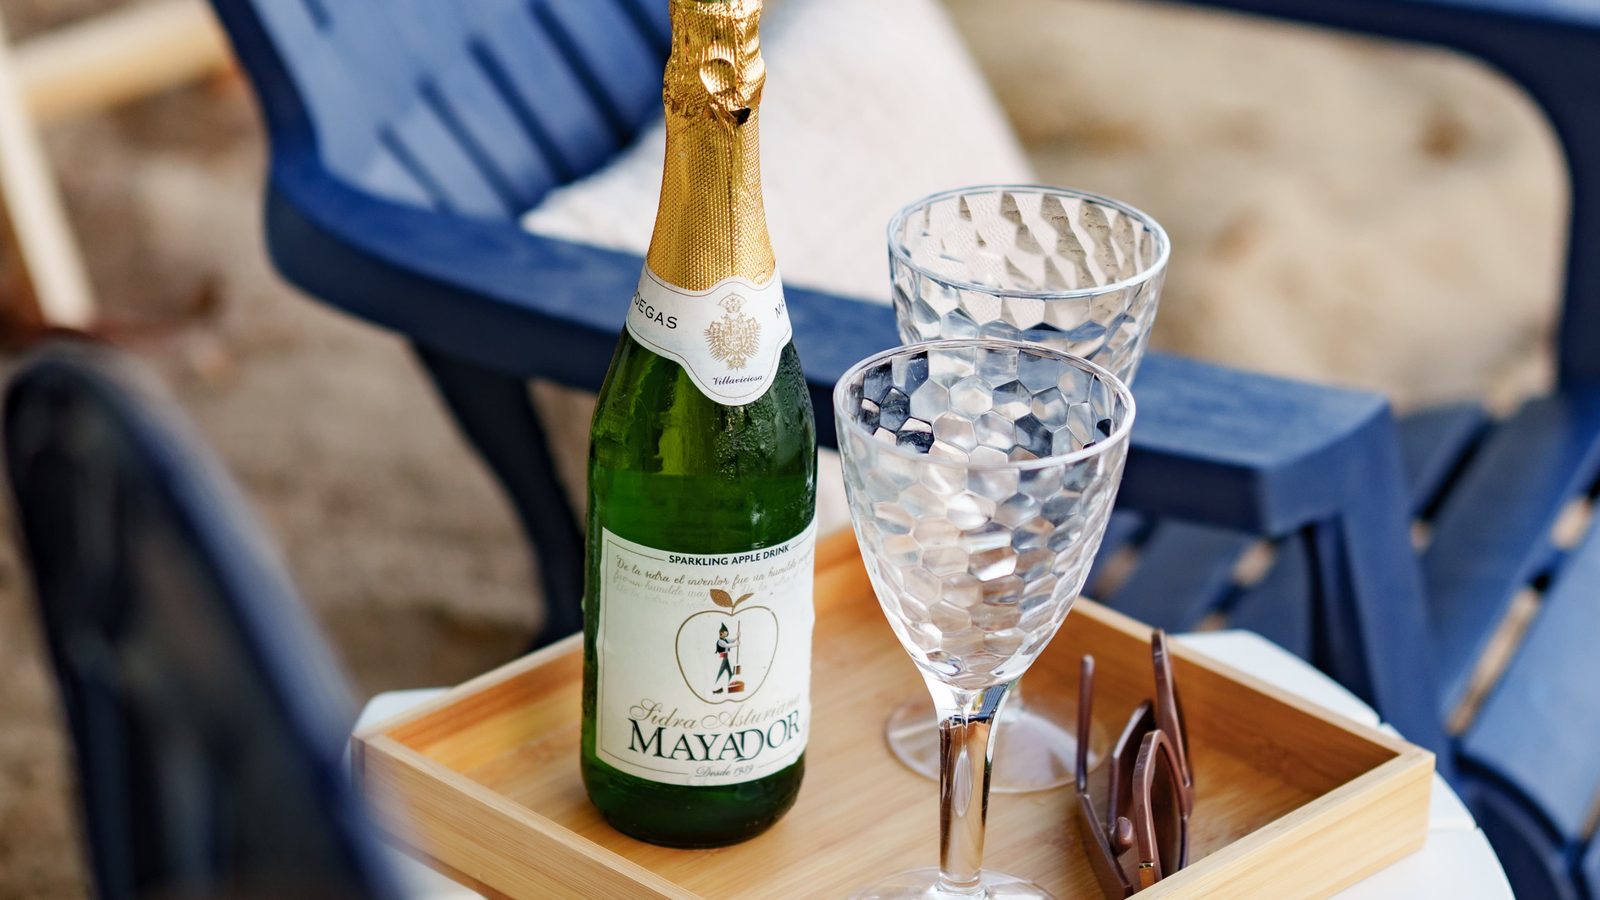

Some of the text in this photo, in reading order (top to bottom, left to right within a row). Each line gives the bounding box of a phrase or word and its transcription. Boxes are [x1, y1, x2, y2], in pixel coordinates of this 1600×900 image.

[634, 291, 678, 330] DEGAS
[713, 375, 764, 386] Villaviciosa
[668, 554, 729, 567] SPARKLING
[731, 553, 761, 565] APPLE
[763, 544, 790, 560] DRINK
[631, 564, 642, 576] la
[674, 574, 686, 585] el
[687, 575, 729, 587] inventor
[628, 698, 699, 730] Sidra
[628, 710, 800, 763] MAYADOR
[695, 764, 732, 778] Desde
